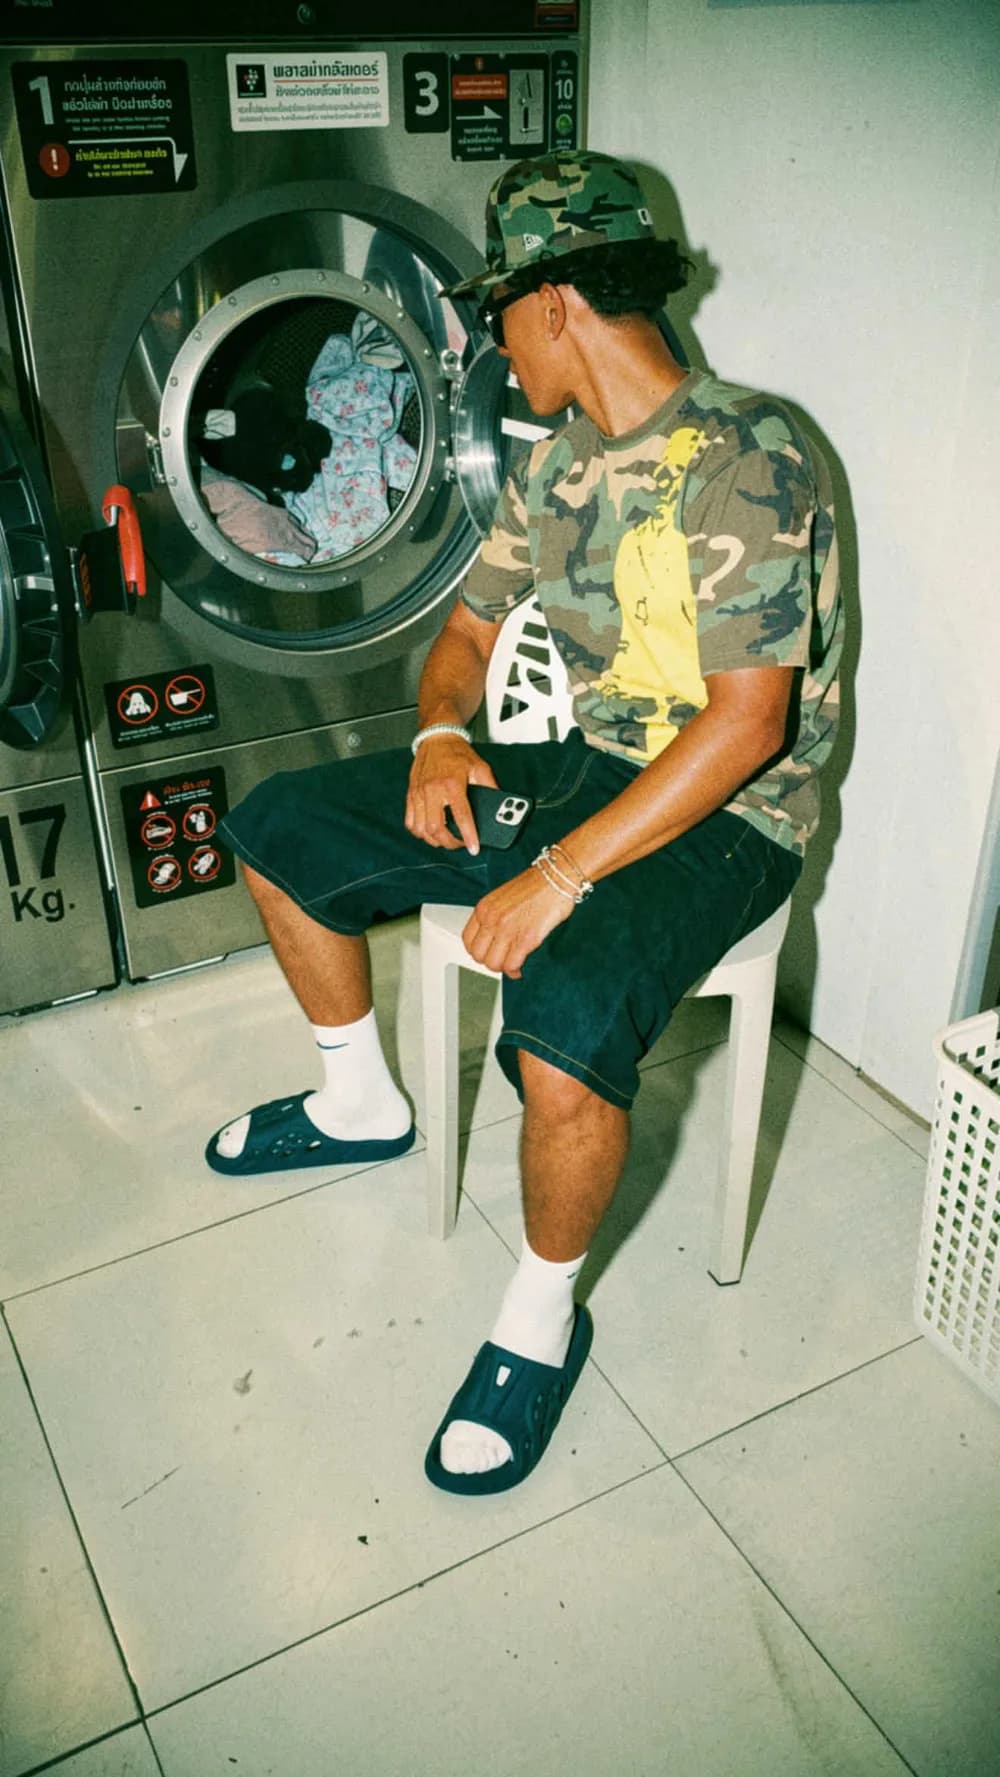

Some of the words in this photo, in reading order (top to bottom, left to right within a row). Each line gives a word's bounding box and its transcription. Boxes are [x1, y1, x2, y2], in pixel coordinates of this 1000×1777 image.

[28, 76, 55, 125] 1
[414, 71, 440, 116] 3
[555, 78, 574, 100] 10
[0, 803, 66, 887] 17
[10, 887, 75, 922] Kg.
